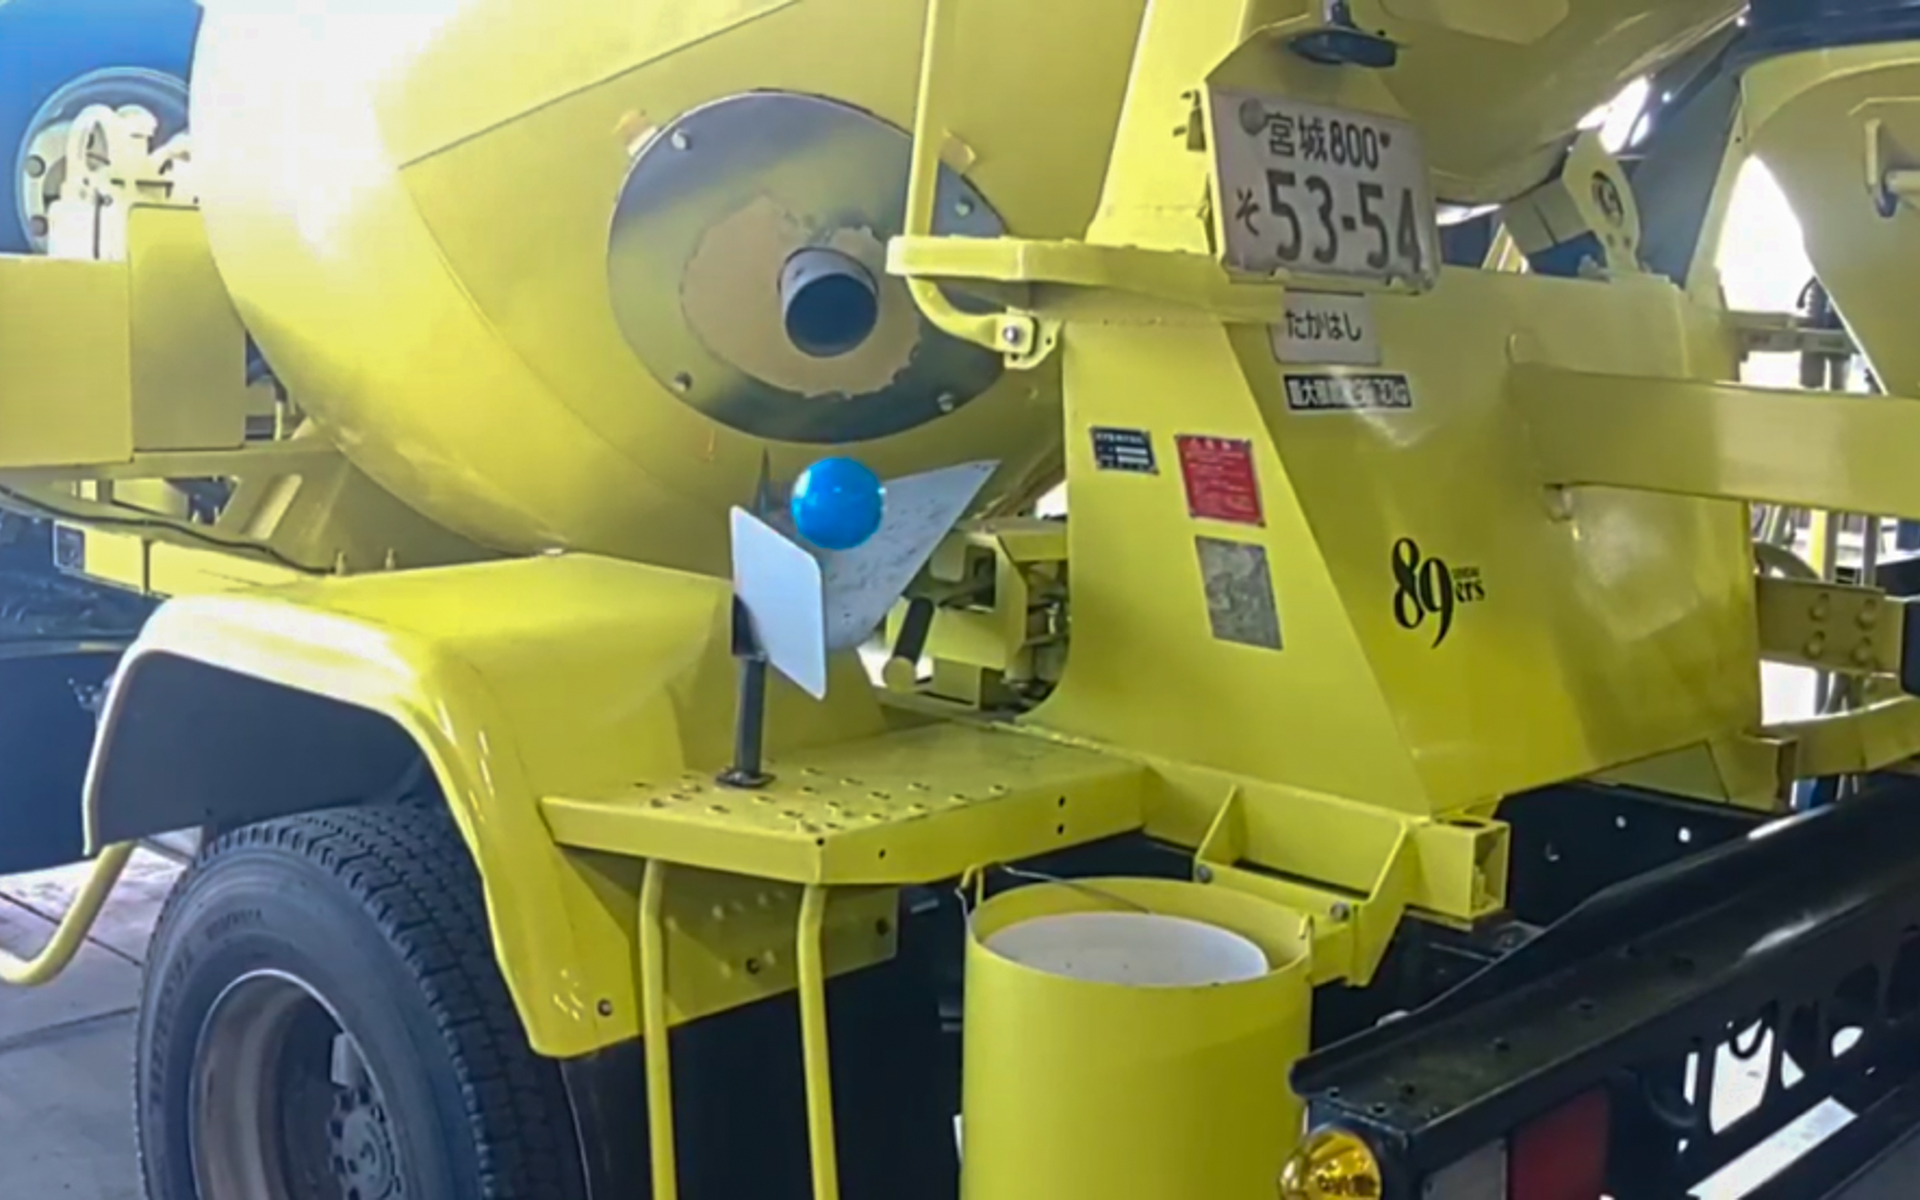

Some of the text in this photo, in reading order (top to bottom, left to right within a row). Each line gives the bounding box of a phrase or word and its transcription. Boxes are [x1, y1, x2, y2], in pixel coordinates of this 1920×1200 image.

[1266, 168, 1422, 274] 53-54
[1285, 309, 1362, 342] たかはし
